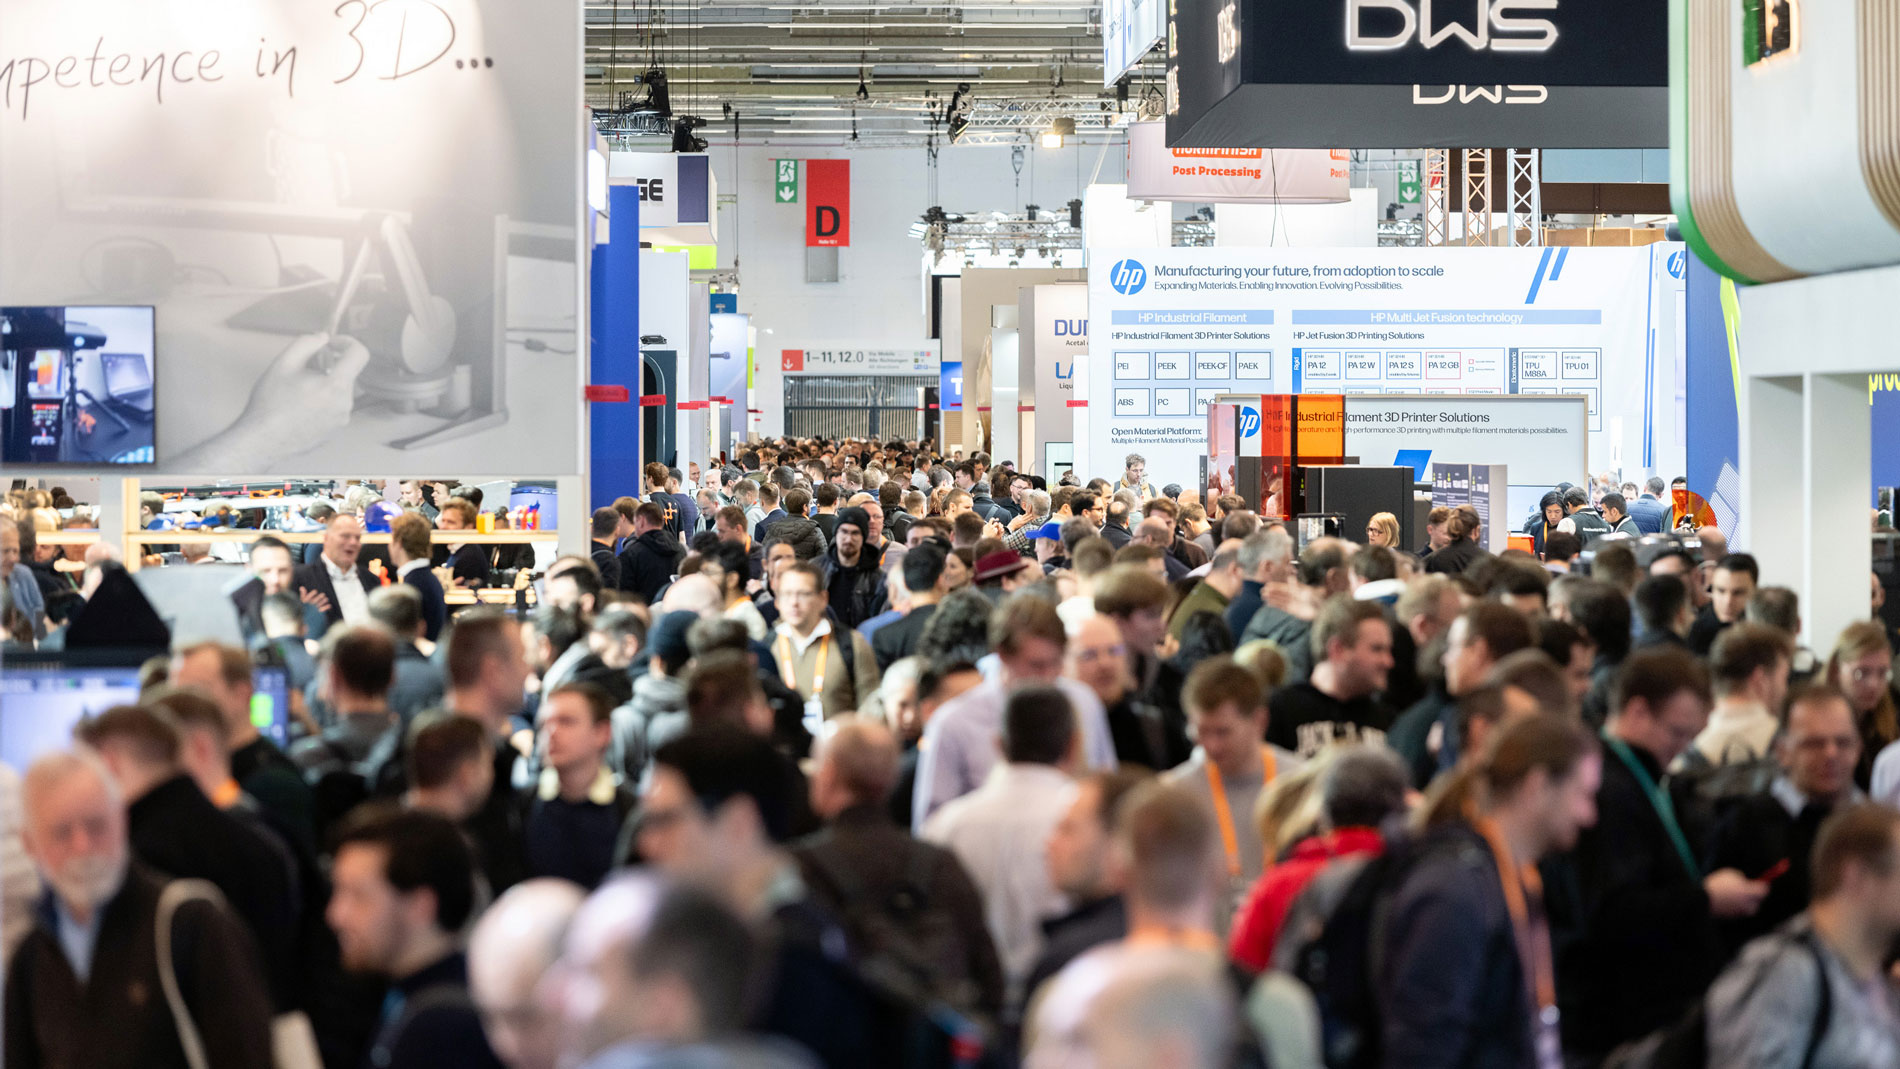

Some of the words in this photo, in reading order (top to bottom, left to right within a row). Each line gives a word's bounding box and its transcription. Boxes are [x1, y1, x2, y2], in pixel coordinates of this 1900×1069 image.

[1346, 0, 1559, 50] DWS
[256, 37, 296, 98] in
[1172, 165, 1196, 176] Post
[1198, 166, 1262, 179] Processing
[816, 205, 840, 236] D
[1112, 258, 1146, 296] hp
[1154, 265, 1242, 278] Manufacturing
[1244, 268, 1271, 279] your
[1272, 265, 1311, 278] future,
[1313, 265, 1342, 277] from
[1343, 265, 1397, 279] adoption
[1398, 266, 1410, 277] to
[1411, 265, 1444, 277] scale
[1154, 281, 1198, 291] Expanding
[1199, 281, 1238, 290] Materials.
[1239, 281, 1274, 291] Enabling
[1319, 281, 1353, 291] Evolving
[1354, 281, 1403, 290] Possibilities.
[1138, 312, 1153, 323] HP
[1155, 312, 1200, 323] Industrial
[1203, 312, 1247, 323] Filament
[1370, 312, 1385, 323] HP
[1387, 312, 1412, 323] Multi
[1413, 312, 1430, 323] Jet
[1431, 312, 1465, 323] Fusion
[1466, 312, 1523, 326] technology
[1111, 331, 1123, 340] HP
[1123, 331, 1160, 340] Industrial
[1160, 331, 1194, 340] Filament
[1194, 331, 1206, 340] 3D
[1206, 331, 1233, 340] Printer
[1233, 331, 1270, 340] Solutions
[1293, 331, 1305, 340] HP
[1305, 331, 1318, 340] Jet
[1319, 331, 1345, 340] Fusion
[1345, 331, 1357, 340] 3D
[1357, 331, 1388, 341] Printing
[1388, 331, 1425, 340] Solutions
[1158, 362, 1177, 370] PEEK
[1198, 362, 1228, 370] PEEK-CF
[1238, 362, 1259, 370] PAEK
[1117, 398, 1134, 406] ABS
[1157, 398, 1169, 406] PC
[1384, 411, 1400, 422] 3D
[1401, 411, 1438, 422] Printer
[1439, 411, 1490, 422] Solutions
[1111, 427, 1130, 436] Open
[1130, 427, 1166, 435] Material
[1166, 427, 1202, 435] Platform:
